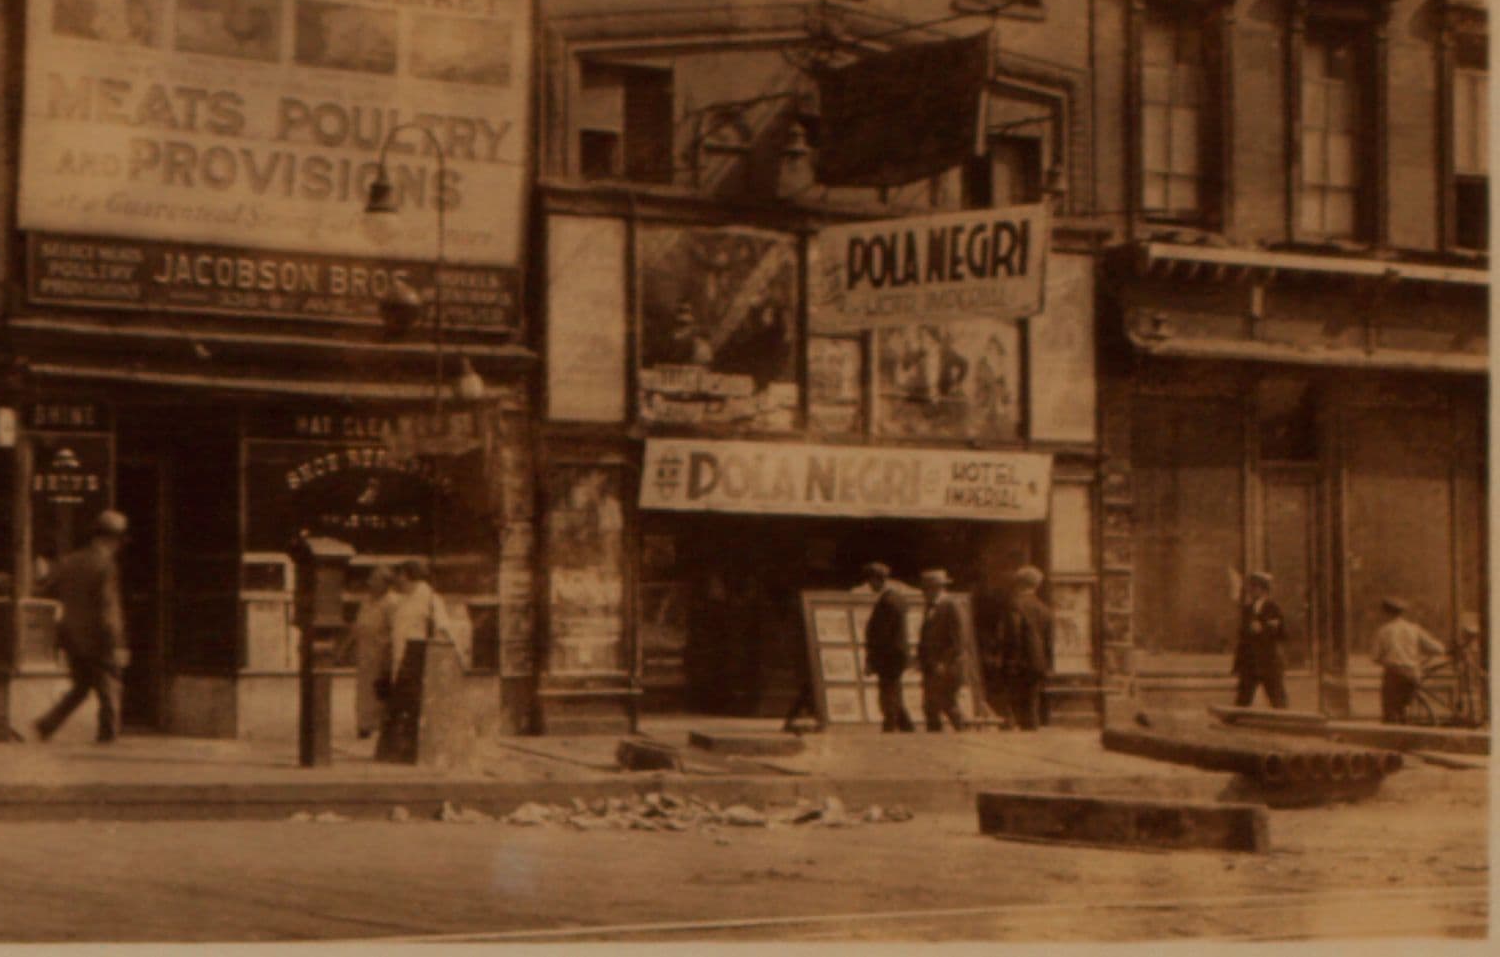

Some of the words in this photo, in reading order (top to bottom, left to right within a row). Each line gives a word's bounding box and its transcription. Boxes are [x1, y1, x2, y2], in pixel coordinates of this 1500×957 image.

[45, 71, 247, 139] MEATS
[277, 94, 513, 163] POULTRY
[126, 137, 465, 212] PROVISIONS
[152, 250, 320, 295] JACOBSON
[846, 227, 921, 291] POLA
[924, 218, 1031, 283] NEGRI
[951, 460, 1021, 487] HOTEL
